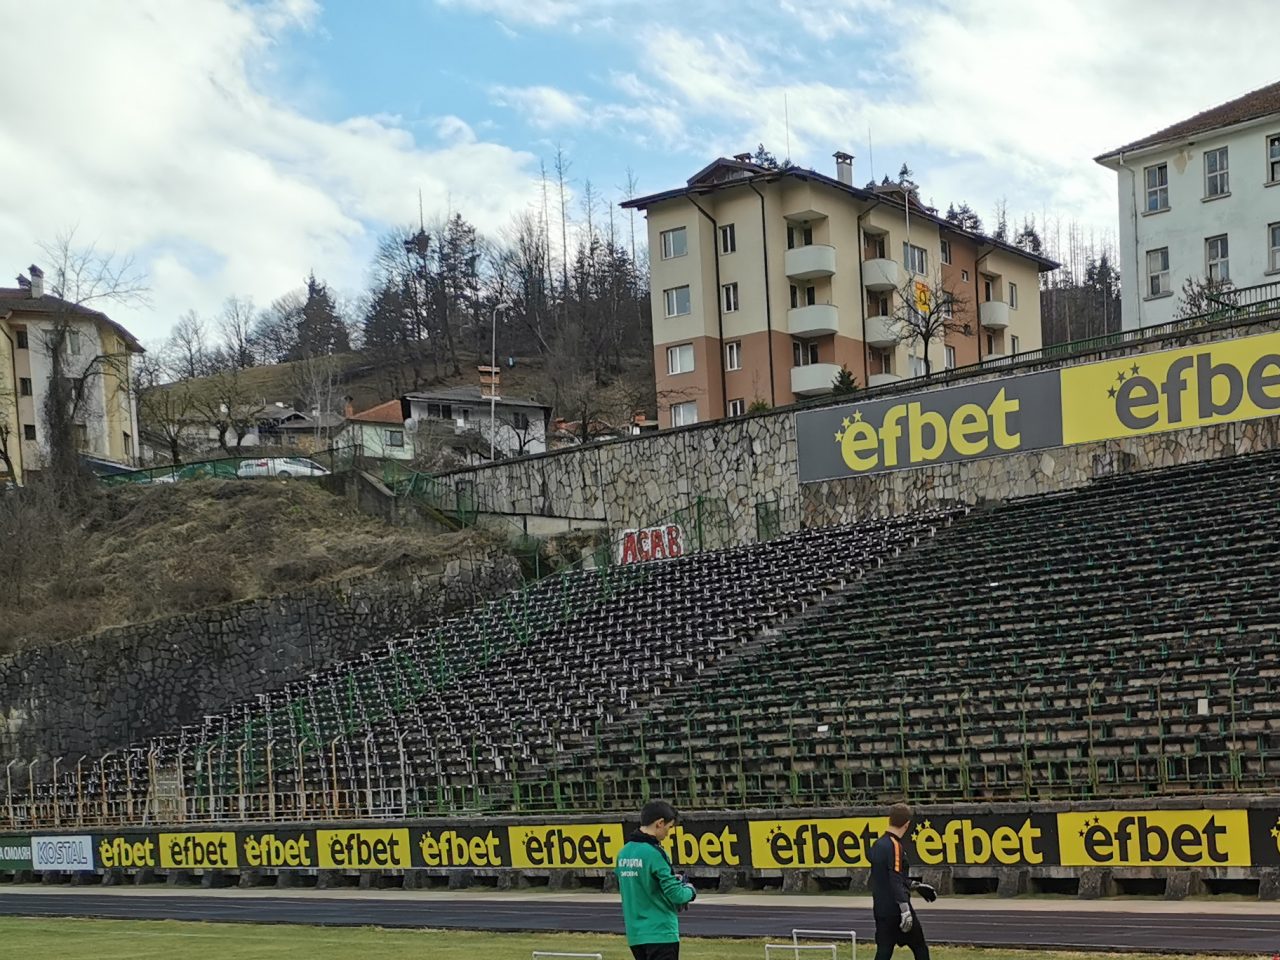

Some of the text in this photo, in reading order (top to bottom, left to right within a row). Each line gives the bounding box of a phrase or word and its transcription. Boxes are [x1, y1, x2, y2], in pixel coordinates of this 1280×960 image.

[839, 387, 1021, 473] efbet
[622, 524, 682, 565] ACAB
[37, 841, 88, 864] KOSTAL
[100, 837, 155, 867] efbet
[170, 835, 228, 866] efbet
[245, 833, 311, 866] efbet
[330, 833, 400, 866] efbet
[421, 830, 501, 866] efbet
[525, 828, 614, 865] efbet
[661, 825, 740, 866] fbet
[915, 817, 1043, 865] efbet
[1083, 814, 1229, 863] efbet
